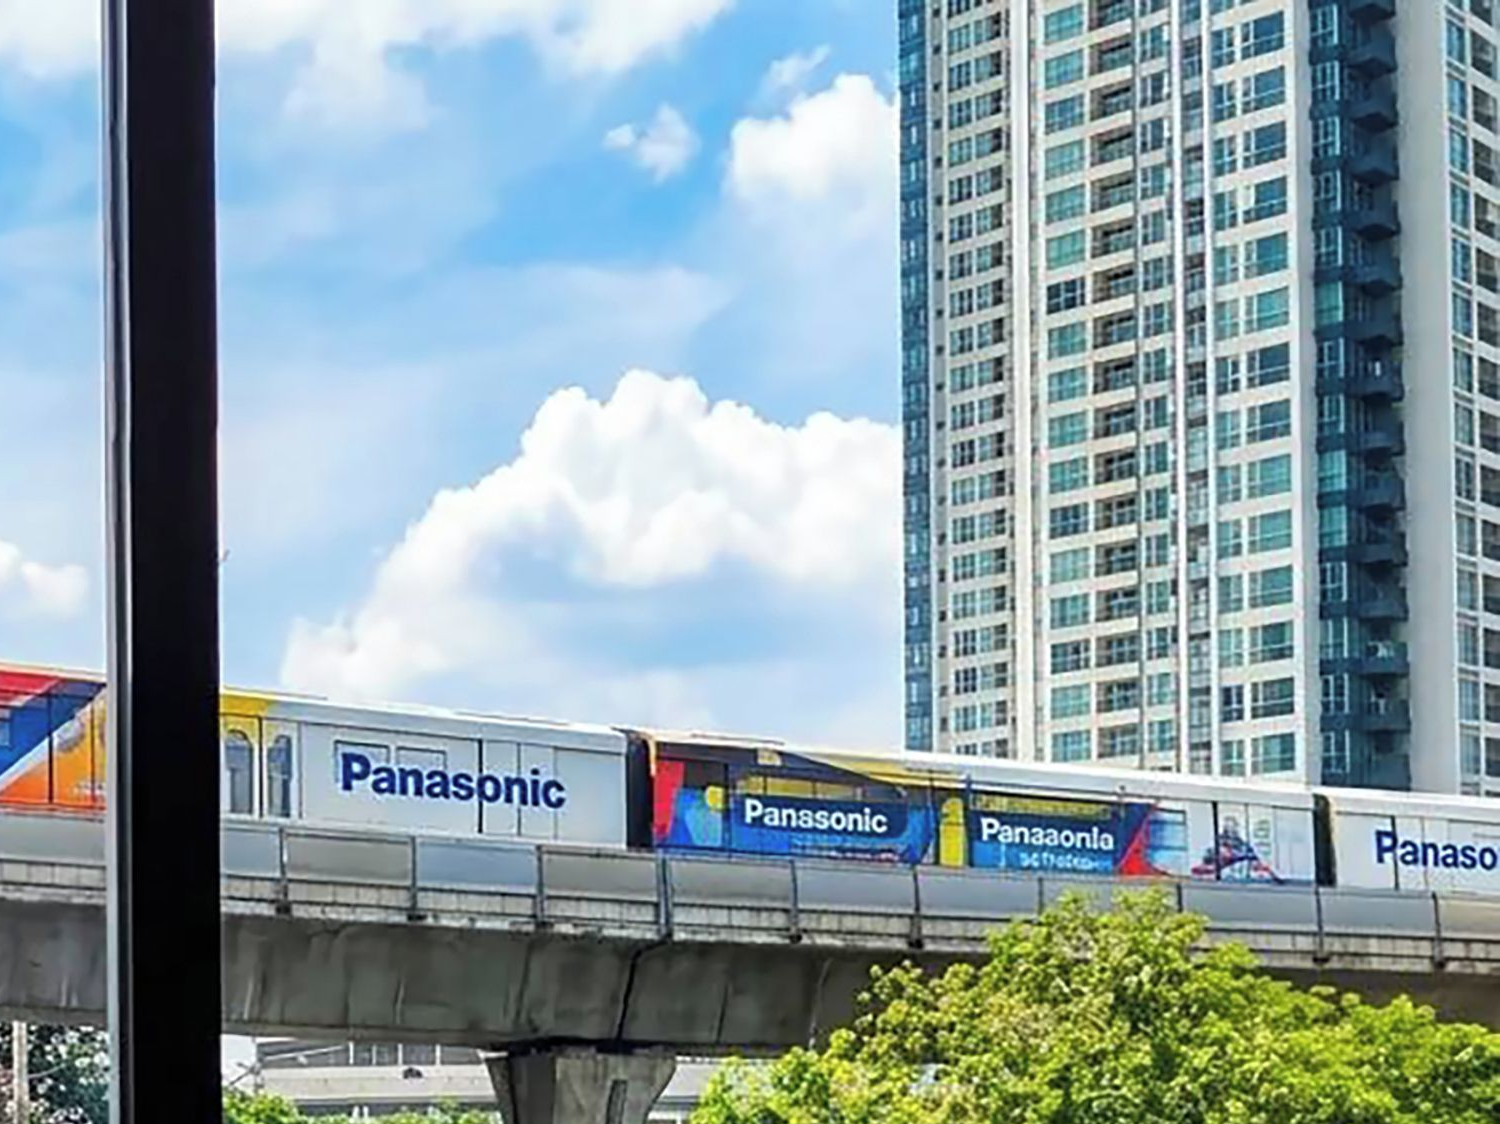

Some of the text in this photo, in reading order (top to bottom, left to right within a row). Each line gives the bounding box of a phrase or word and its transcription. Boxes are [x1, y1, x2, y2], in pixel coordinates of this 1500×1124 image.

[341, 752, 566, 808] Panasonic
[744, 798, 888, 833] Panasonic
[1375, 829, 1498, 871] Panaso
